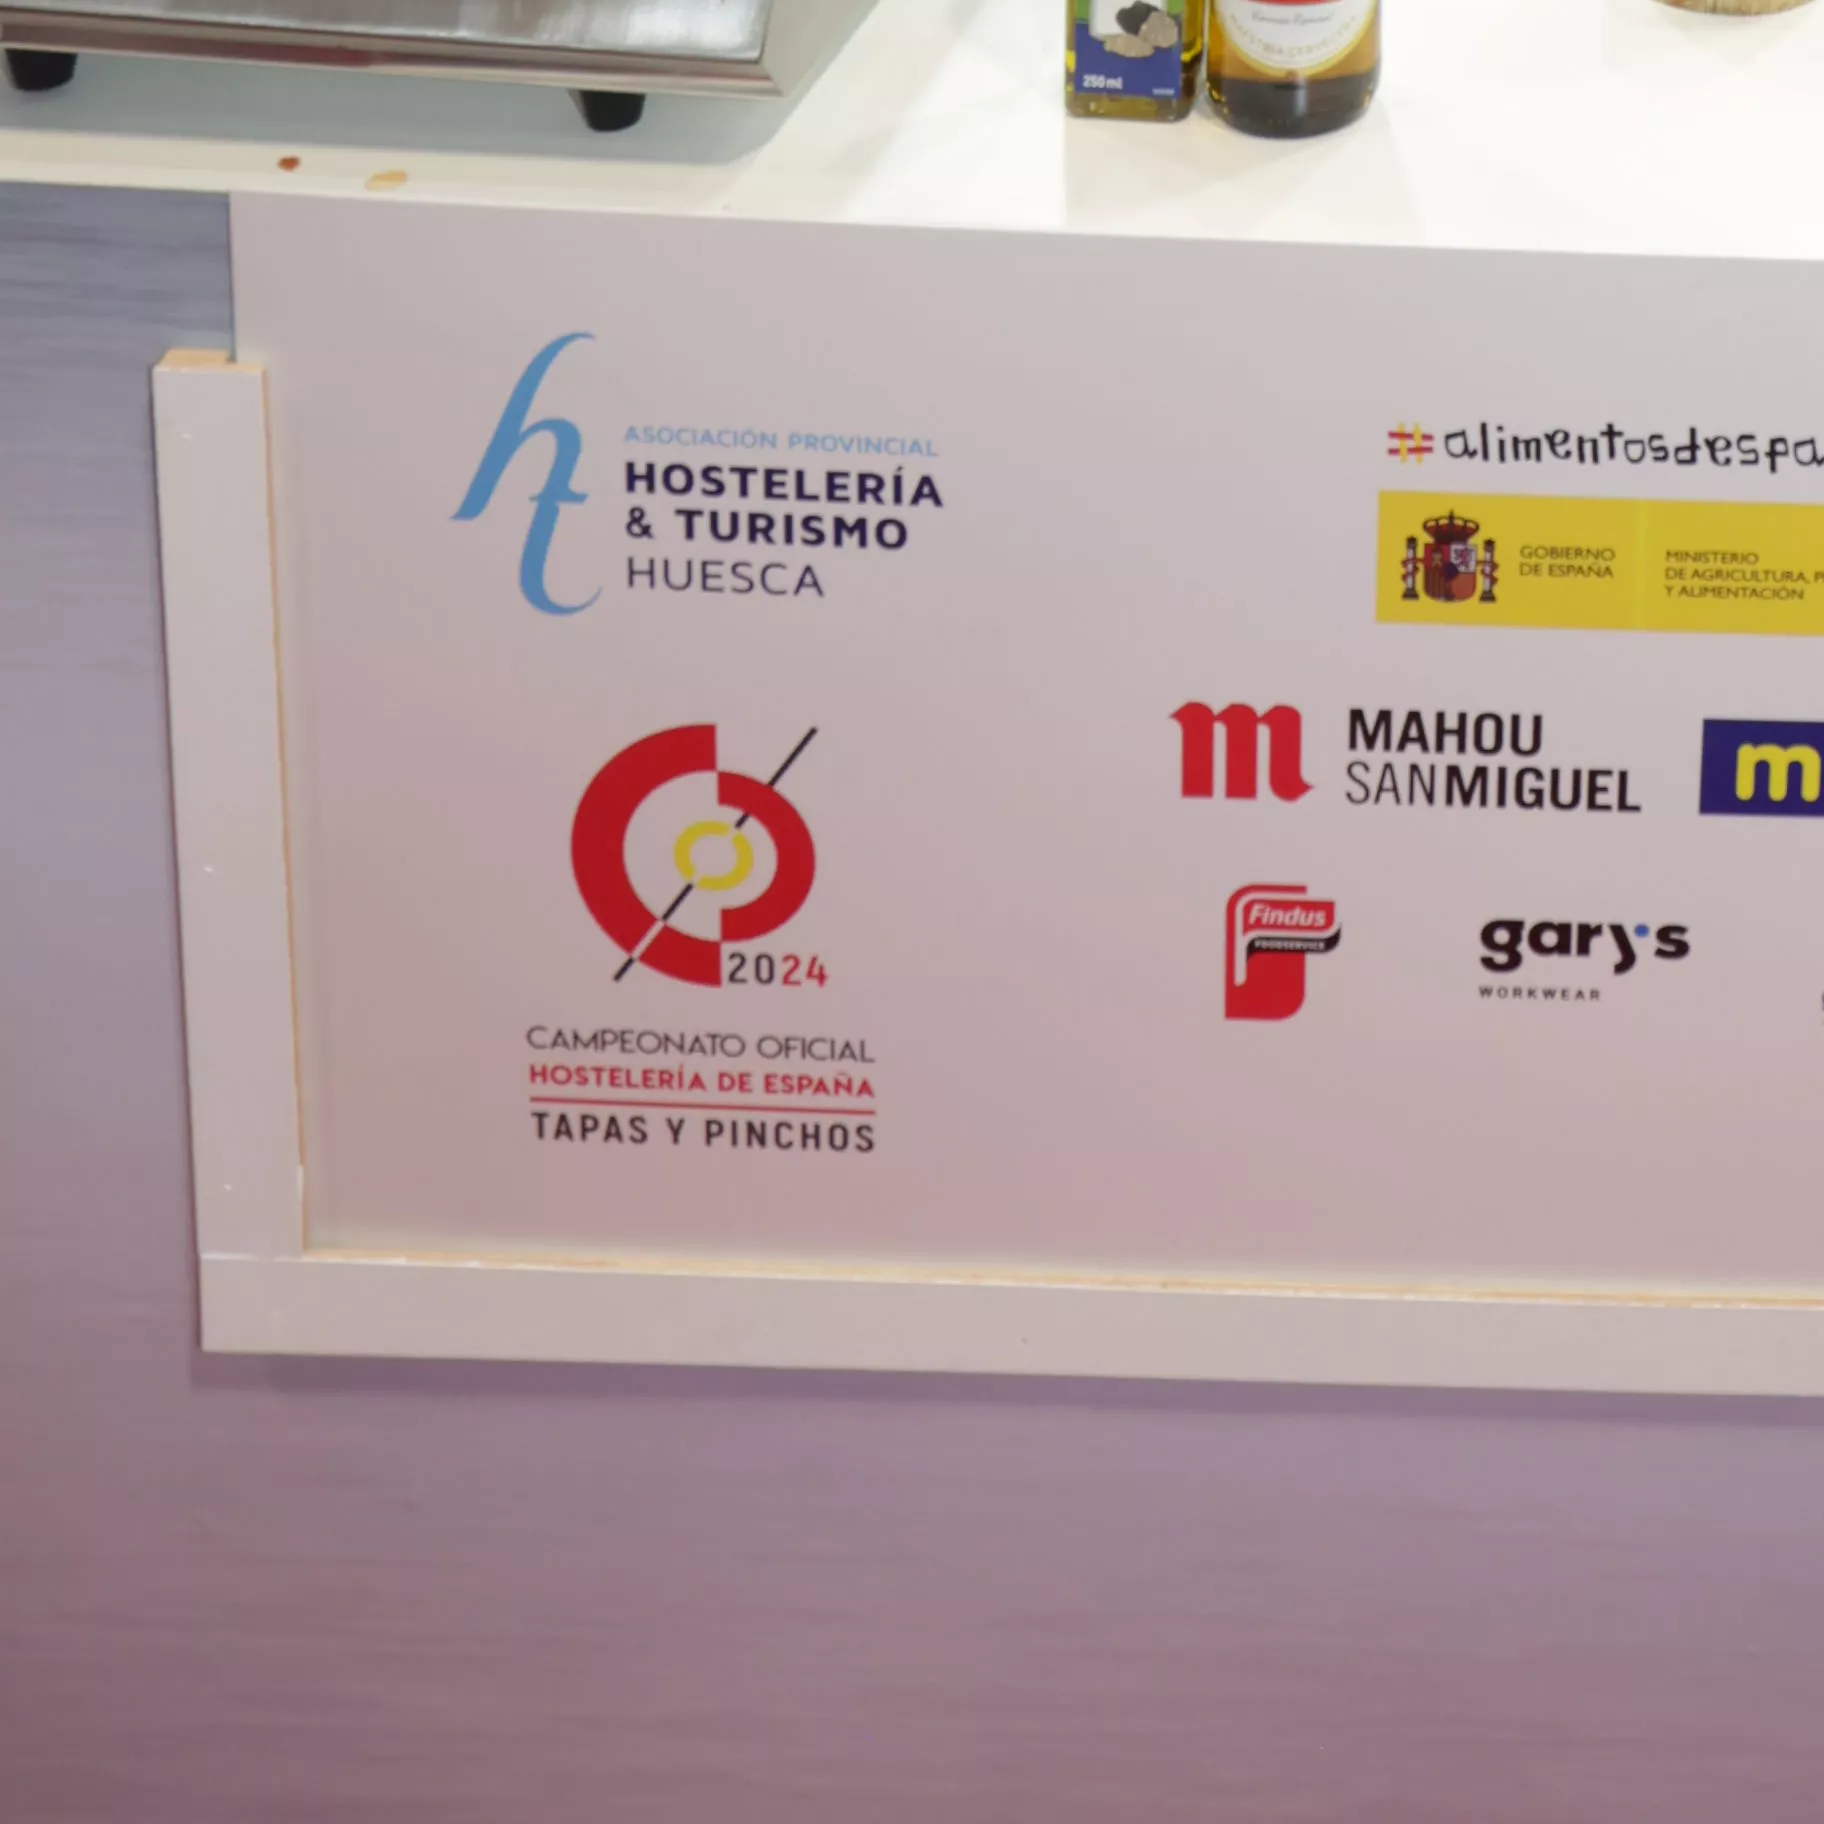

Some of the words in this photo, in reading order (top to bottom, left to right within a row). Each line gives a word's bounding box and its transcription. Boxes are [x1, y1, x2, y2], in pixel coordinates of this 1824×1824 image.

[625, 424, 777, 449] ASOCIACIÓN
[788, 433, 939, 457] PROVINCIAL
[625, 460, 943, 508] HOSTELERÍA
[626, 508, 655, 539] &
[675, 510, 909, 549] TURISMO
[1520, 546, 1616, 562] GOBIERNO
[1666, 551, 1759, 565] MINISTERIO
[627, 558, 824, 597] HUESCA
[1520, 563, 1541, 576] DE
[1548, 563, 1613, 579] ESPAÑA
[1666, 567, 1689, 580] DE
[1665, 586, 1674, 597] Y
[1678, 585, 1804, 600] ALIMENTACIÓN
[1348, 709, 1544, 758] MAHOU
[1346, 761, 1641, 812] SANMIGUEL
[1249, 903, 1326, 927] Findus
[1254, 939, 1325, 951] FOODSERVICE
[729, 953, 828, 988] 2024
[1479, 986, 1601, 1001] WORKWEAR
[527, 1026, 746, 1059] CAMPEONATO
[757, 1035, 875, 1063] OFICIAL
[529, 1064, 706, 1093] HOSTELERÍA
[718, 1072, 752, 1094] DE
[764, 1070, 875, 1098] ESPAÑA
[532, 1112, 648, 1144] TAPAS
[667, 1117, 686, 1145] Y
[706, 1120, 875, 1152] PINCHOS
